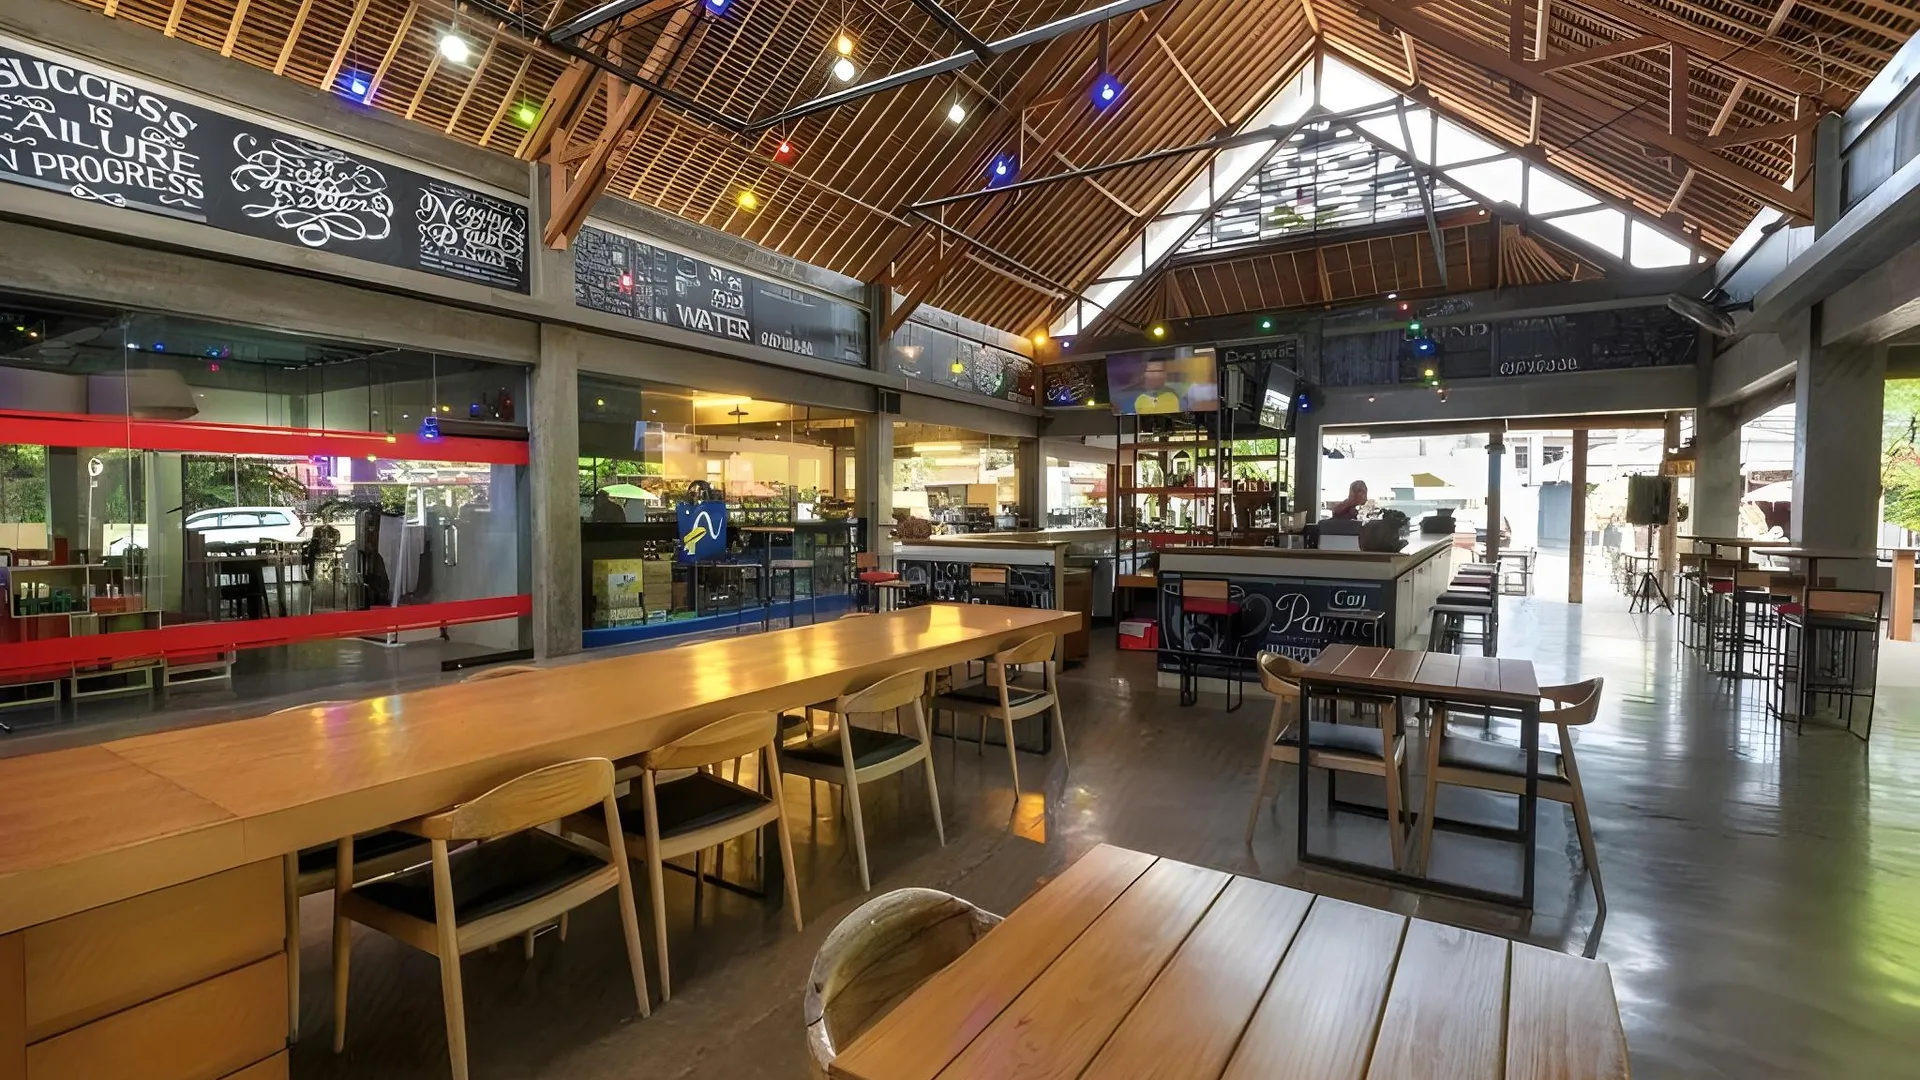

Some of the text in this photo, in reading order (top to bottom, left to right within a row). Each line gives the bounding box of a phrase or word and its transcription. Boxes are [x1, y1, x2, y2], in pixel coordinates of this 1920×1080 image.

[88, 103, 113, 128] IS
[0, 148, 204, 199] N PROGRESS
[676, 303, 750, 341] WATER
